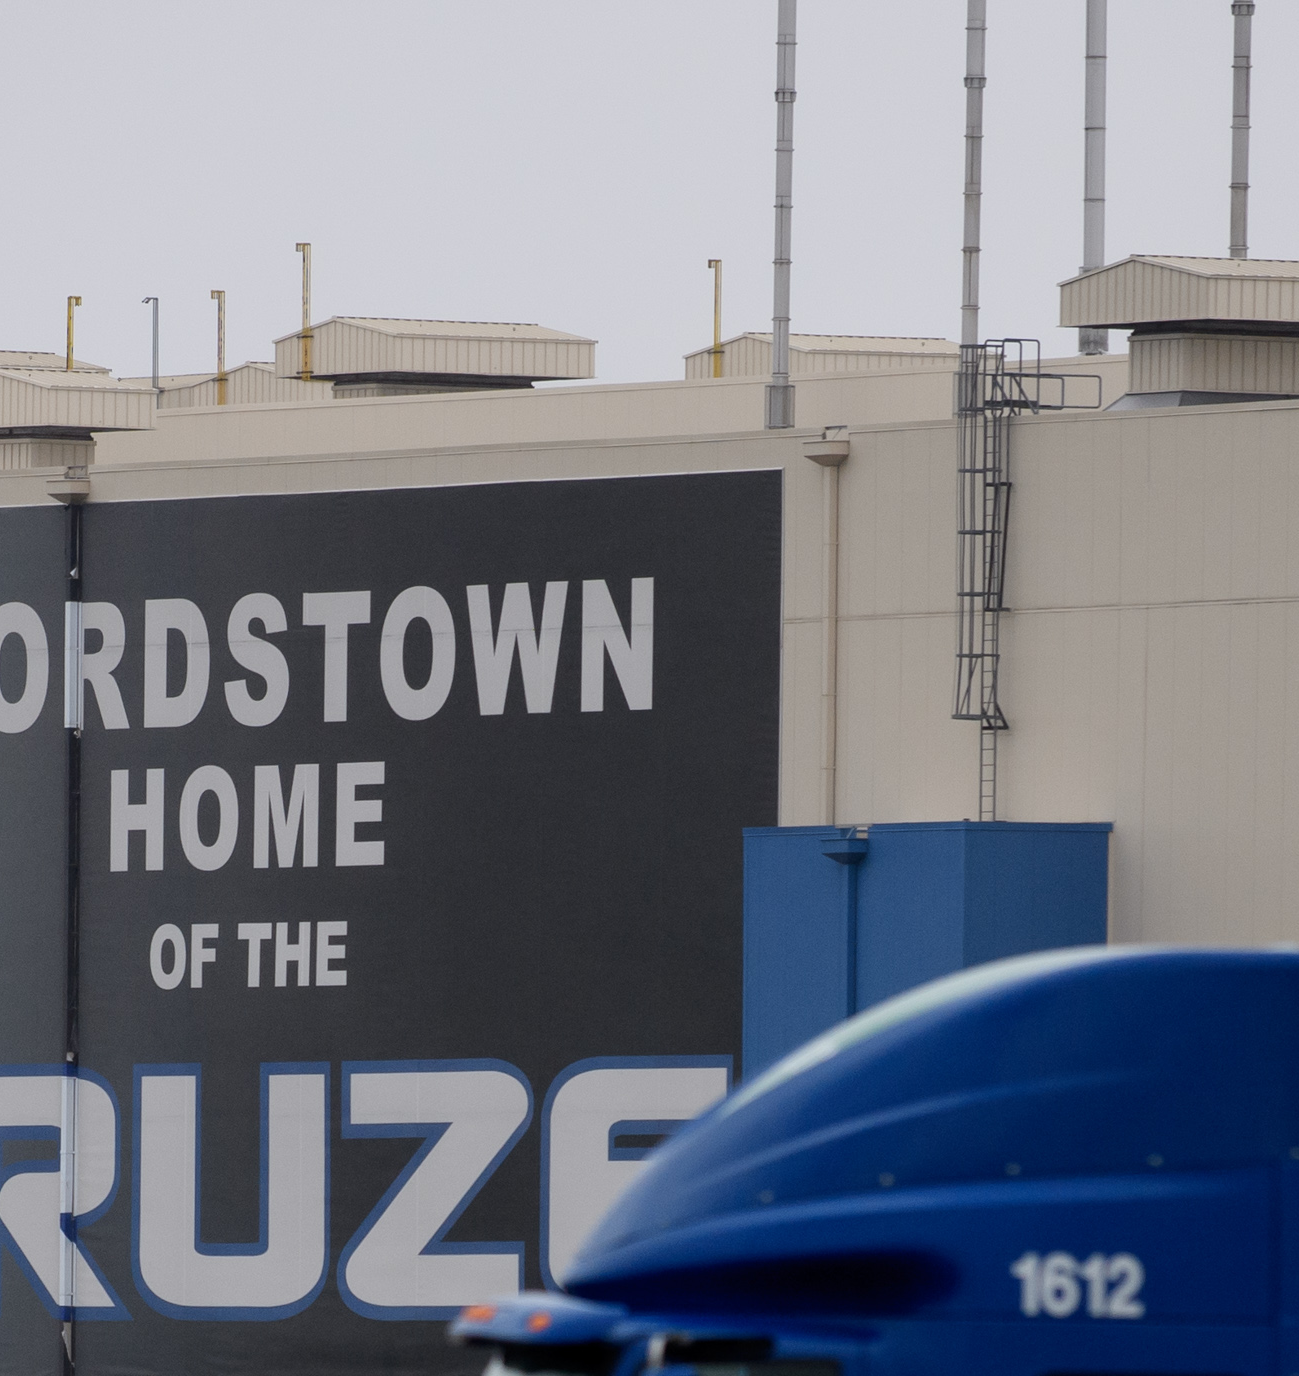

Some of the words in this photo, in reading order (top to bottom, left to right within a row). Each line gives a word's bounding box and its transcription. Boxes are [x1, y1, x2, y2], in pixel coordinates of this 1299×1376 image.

[109, 761, 386, 873] HOME
[149, 922, 220, 991] OF
[237, 920, 349, 989] THE
[1009, 1251, 1146, 1319] 1612
